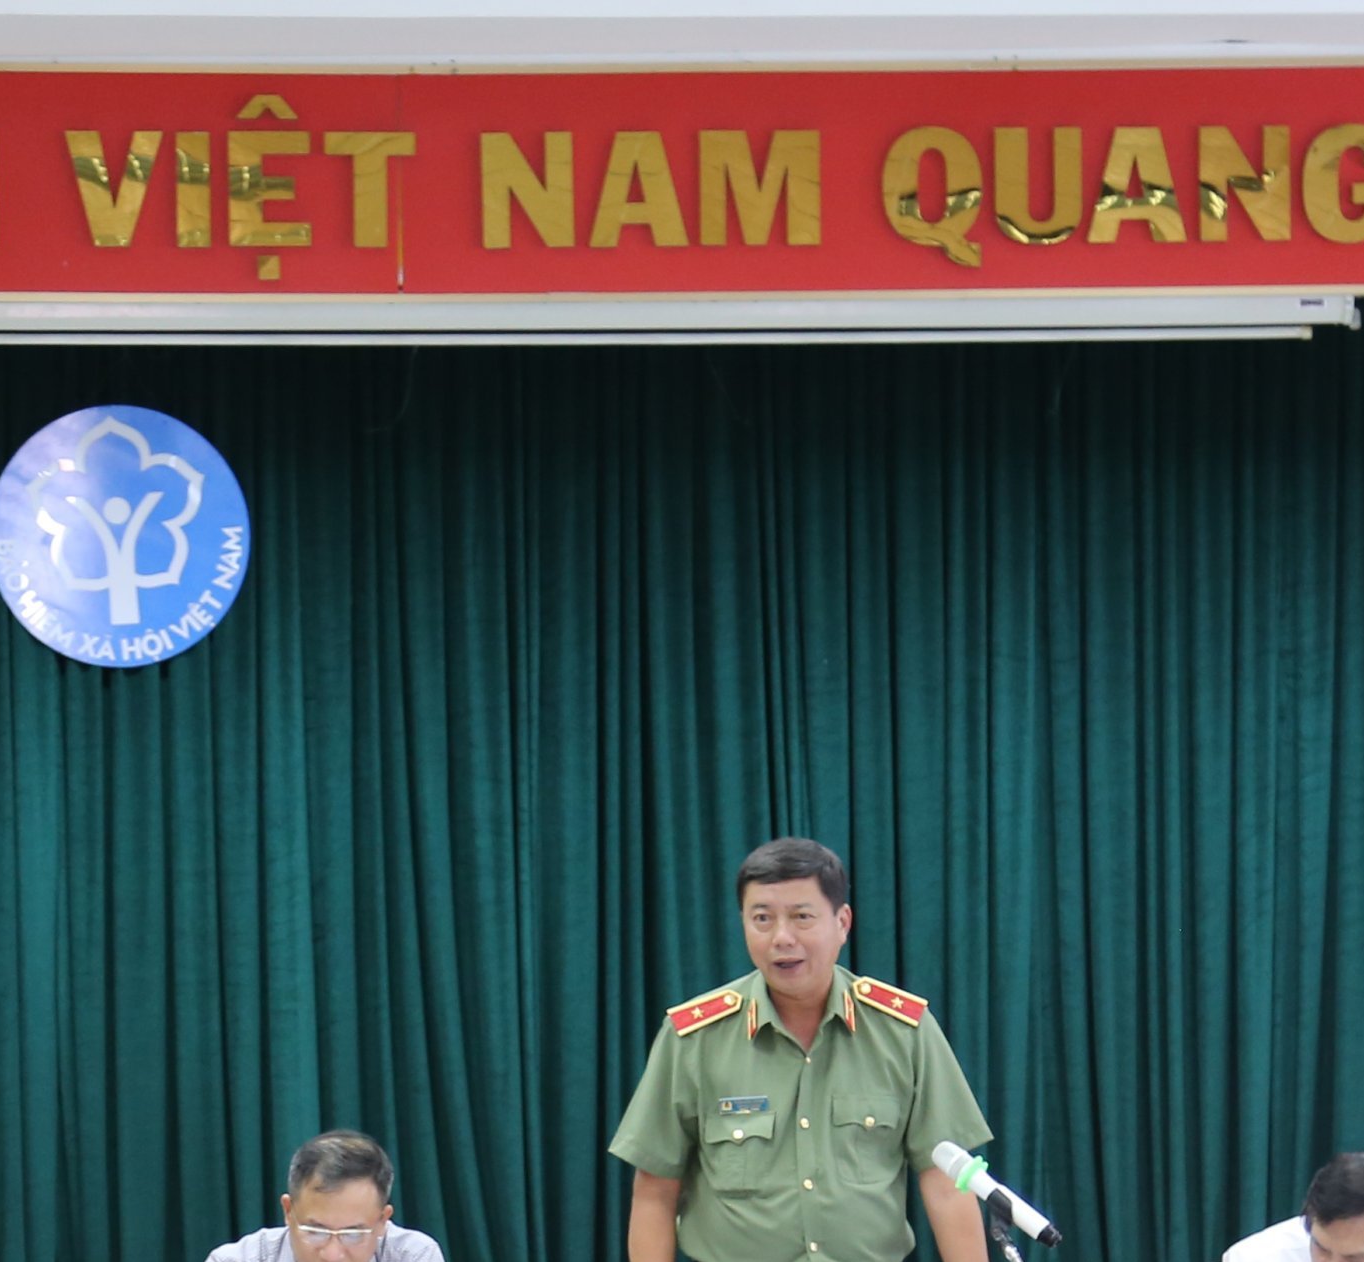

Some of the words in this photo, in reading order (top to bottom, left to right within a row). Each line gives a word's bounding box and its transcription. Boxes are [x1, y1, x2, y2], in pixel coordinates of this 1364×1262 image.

[65, 94, 415, 280] VIỆT
[479, 129, 822, 249] NAM
[120, 628, 175, 663] HỘI
[168, 589, 223, 640] VIỆT
[211, 525, 243, 590] NAM
